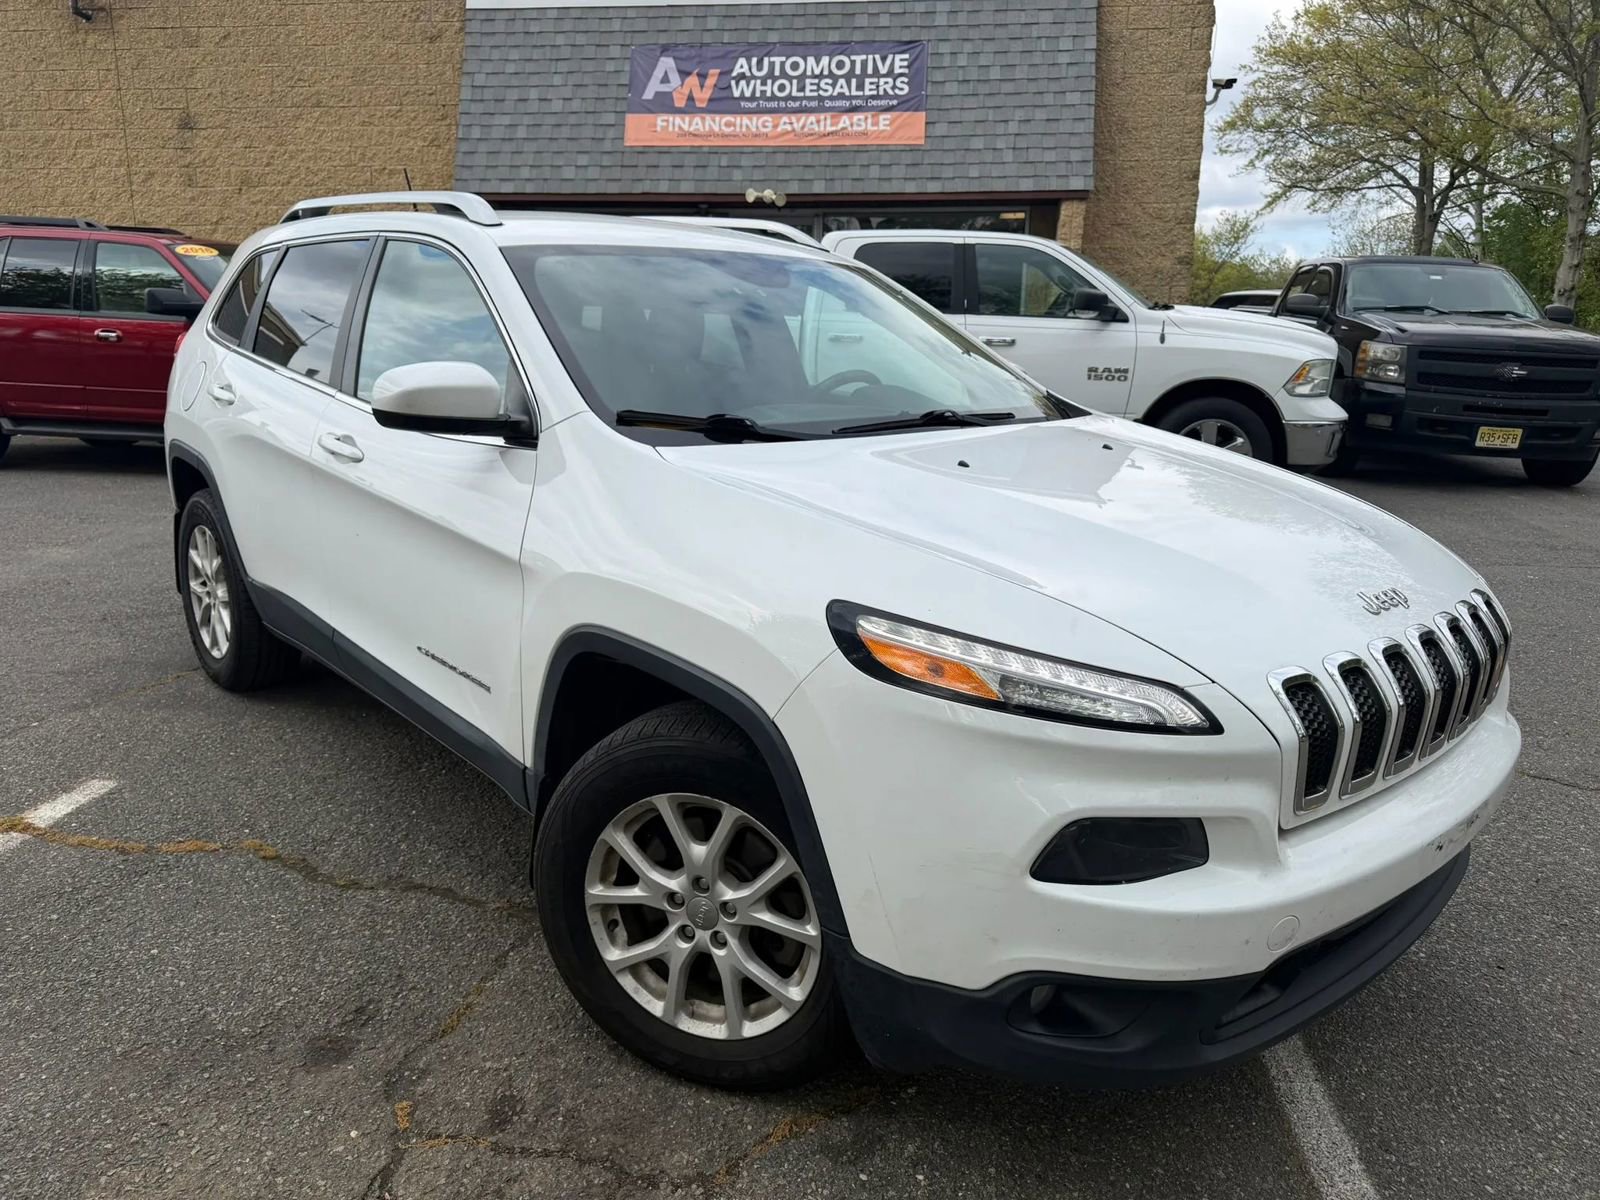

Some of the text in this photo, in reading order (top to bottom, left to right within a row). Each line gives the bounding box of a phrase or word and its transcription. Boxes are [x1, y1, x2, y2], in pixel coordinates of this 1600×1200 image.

[731, 54, 910, 77] AUTOMOTIVE
[641, 56, 721, 108] AW
[730, 77, 910, 98] WHOLESALERS
[740, 101, 757, 109] Your
[759, 100, 778, 109] Trust
[787, 100, 801, 108] Our
[802, 100, 819, 108] Fuel
[824, 100, 850, 108] Quality
[852, 99, 867, 107] You
[868, 99, 898, 107] Deserve
[656, 114, 891, 132] FINANCING AVAILABLE
[1087, 366, 1129, 374] RAM
[1087, 373, 1128, 382] 1500
[1479, 432, 1519, 444] R35 SFB
[1357, 587, 1410, 616] Jeep
